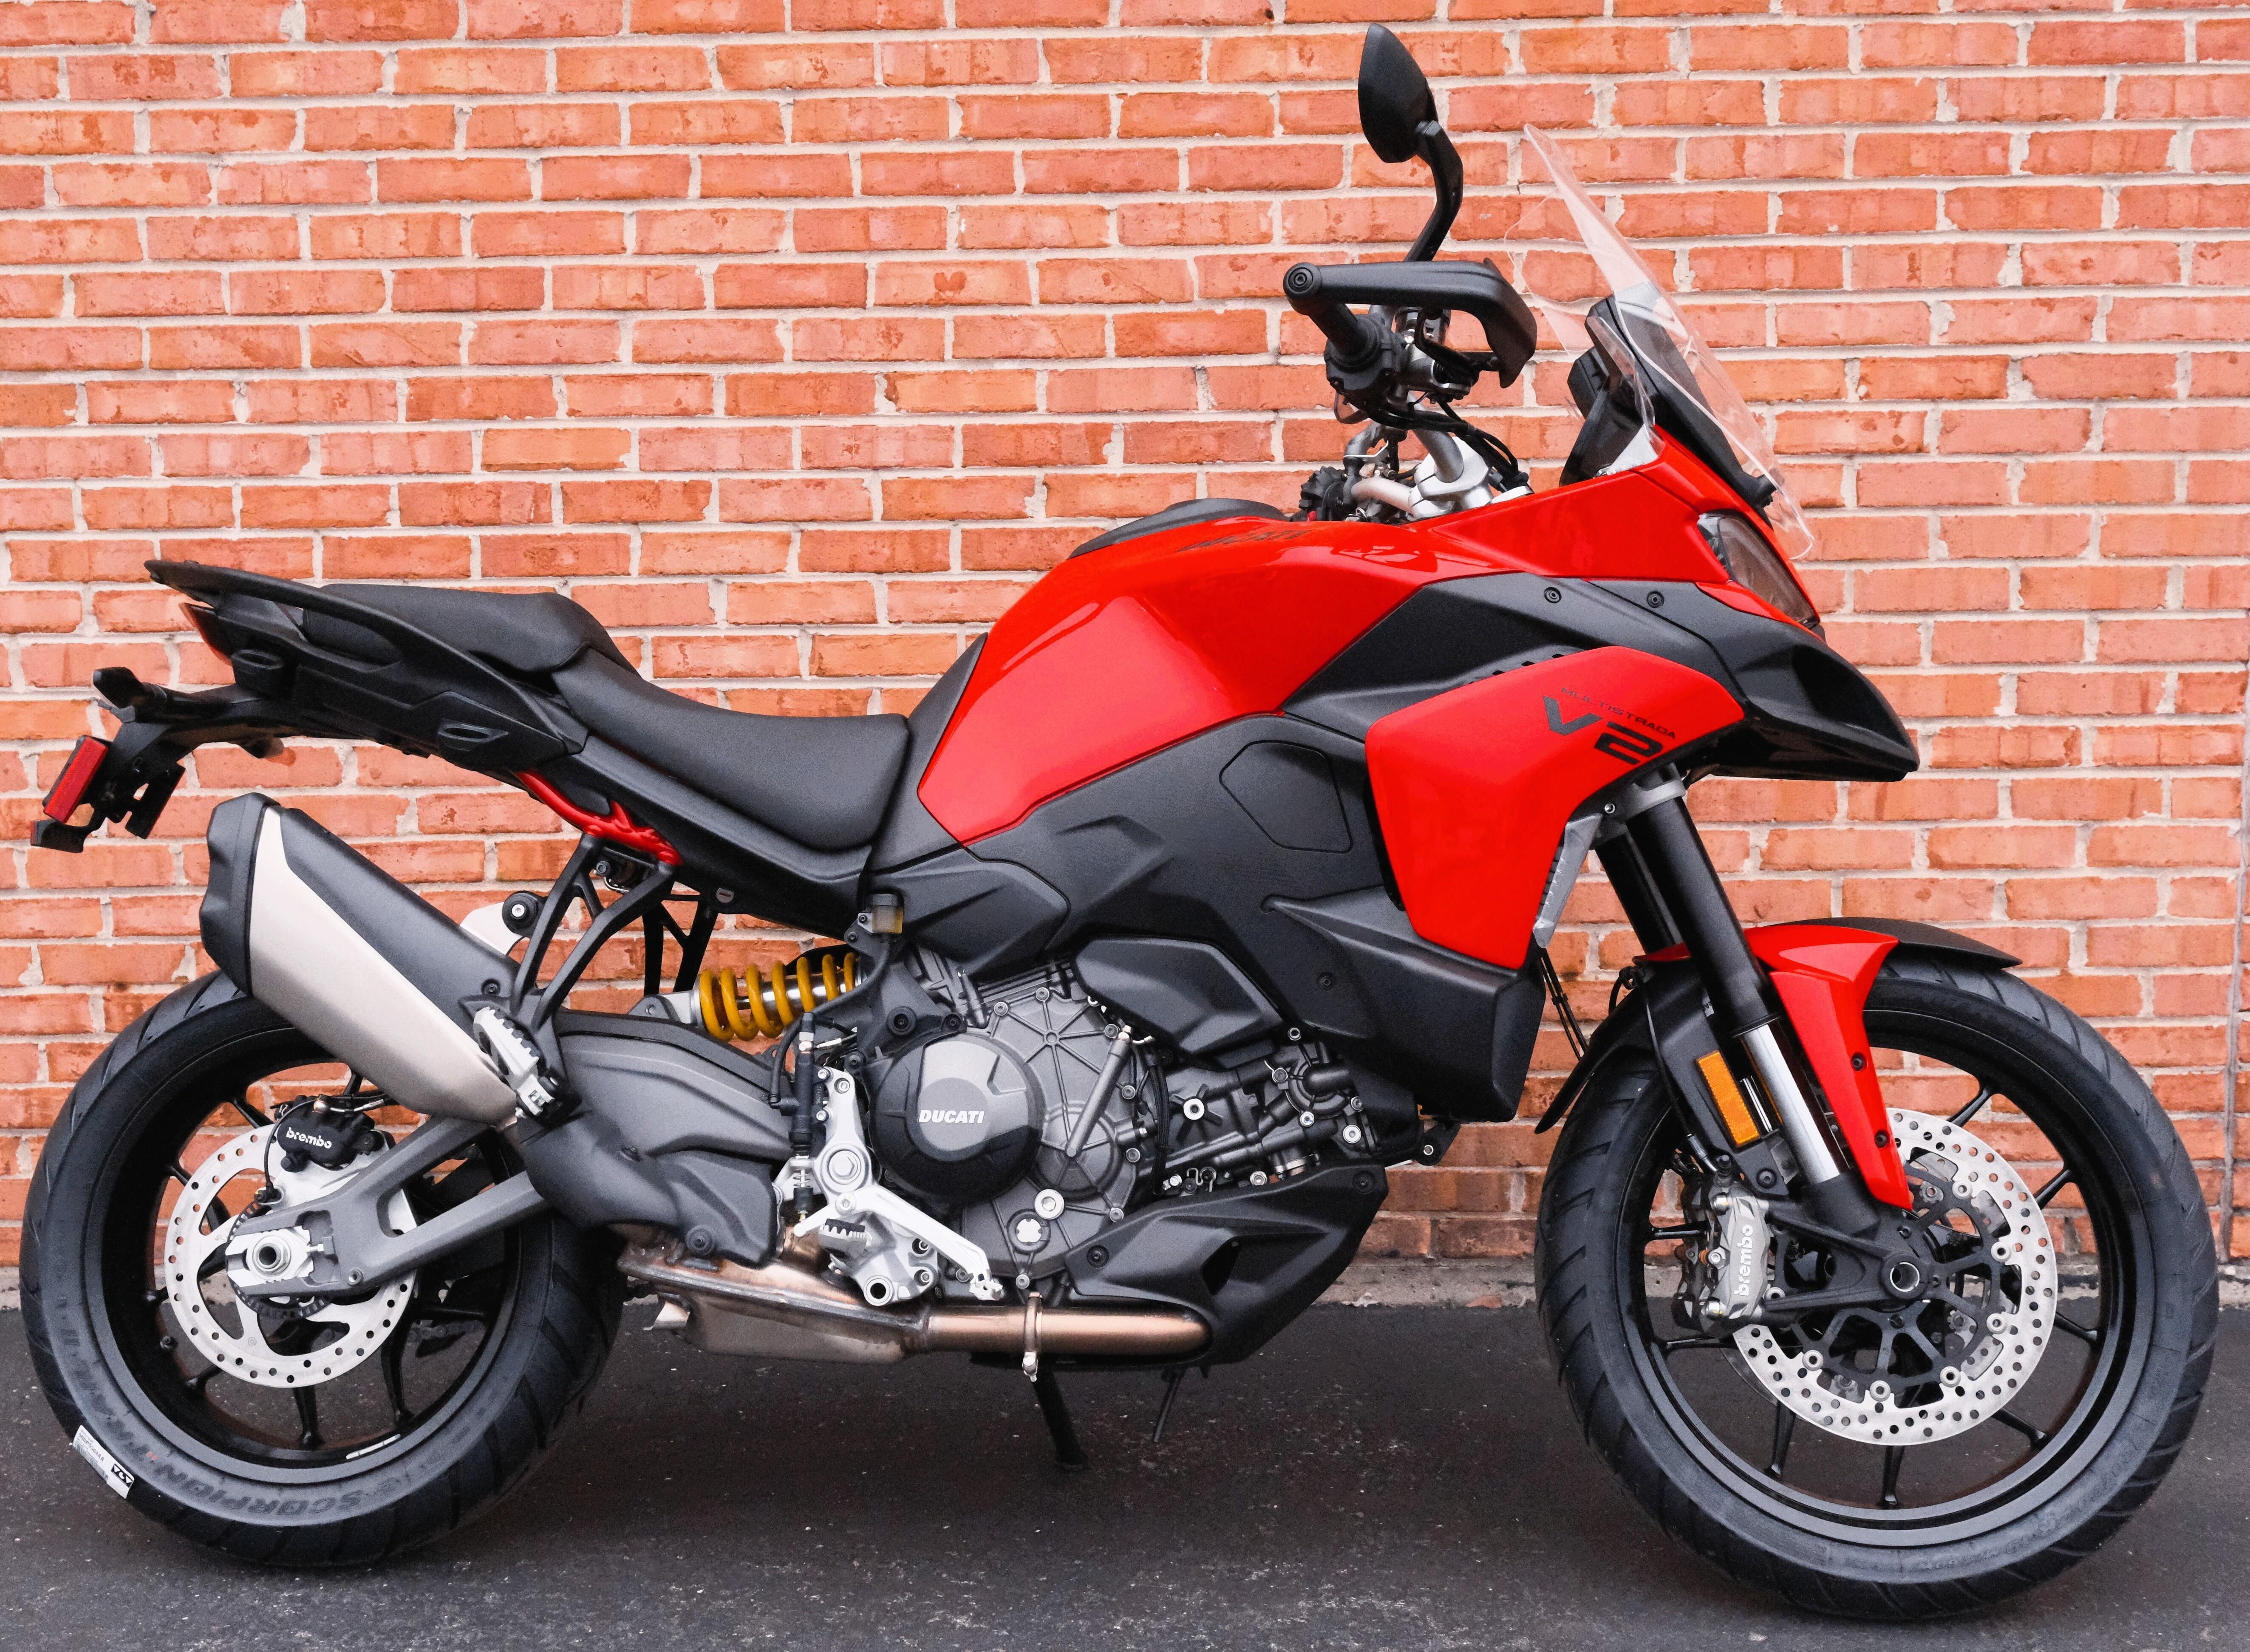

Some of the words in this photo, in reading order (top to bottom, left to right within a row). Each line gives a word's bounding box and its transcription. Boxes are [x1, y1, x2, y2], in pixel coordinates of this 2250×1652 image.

[1561, 687, 1675, 739] MULTISTRADA
[286, 1126, 332, 1149] brembo
[918, 1109, 985, 1124] DUCATI
[1734, 1224, 1753, 1296] brembo
[153, 1464, 364, 1515] SCORPION
